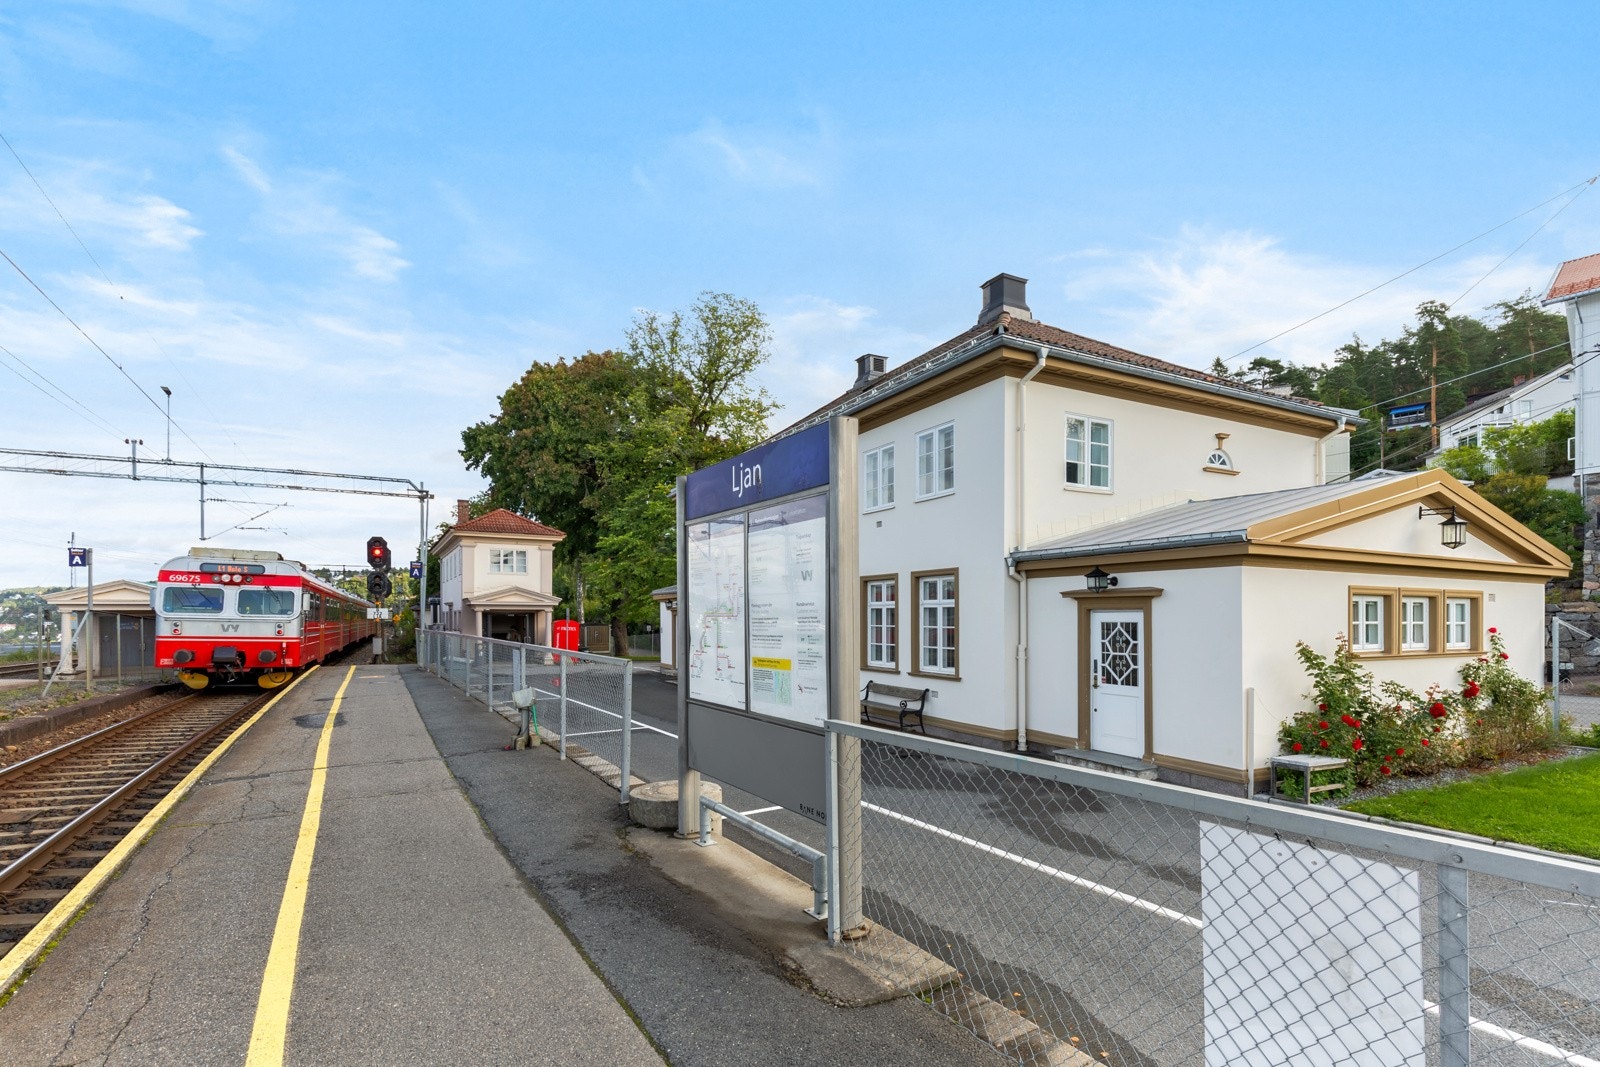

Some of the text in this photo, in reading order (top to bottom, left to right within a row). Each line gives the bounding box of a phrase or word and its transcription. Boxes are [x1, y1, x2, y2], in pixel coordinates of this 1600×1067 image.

[732, 462, 762, 498] Ljan
[72, 555, 82, 565] A
[412, 568, 420, 576] A
[169, 574, 201, 582] 69675
